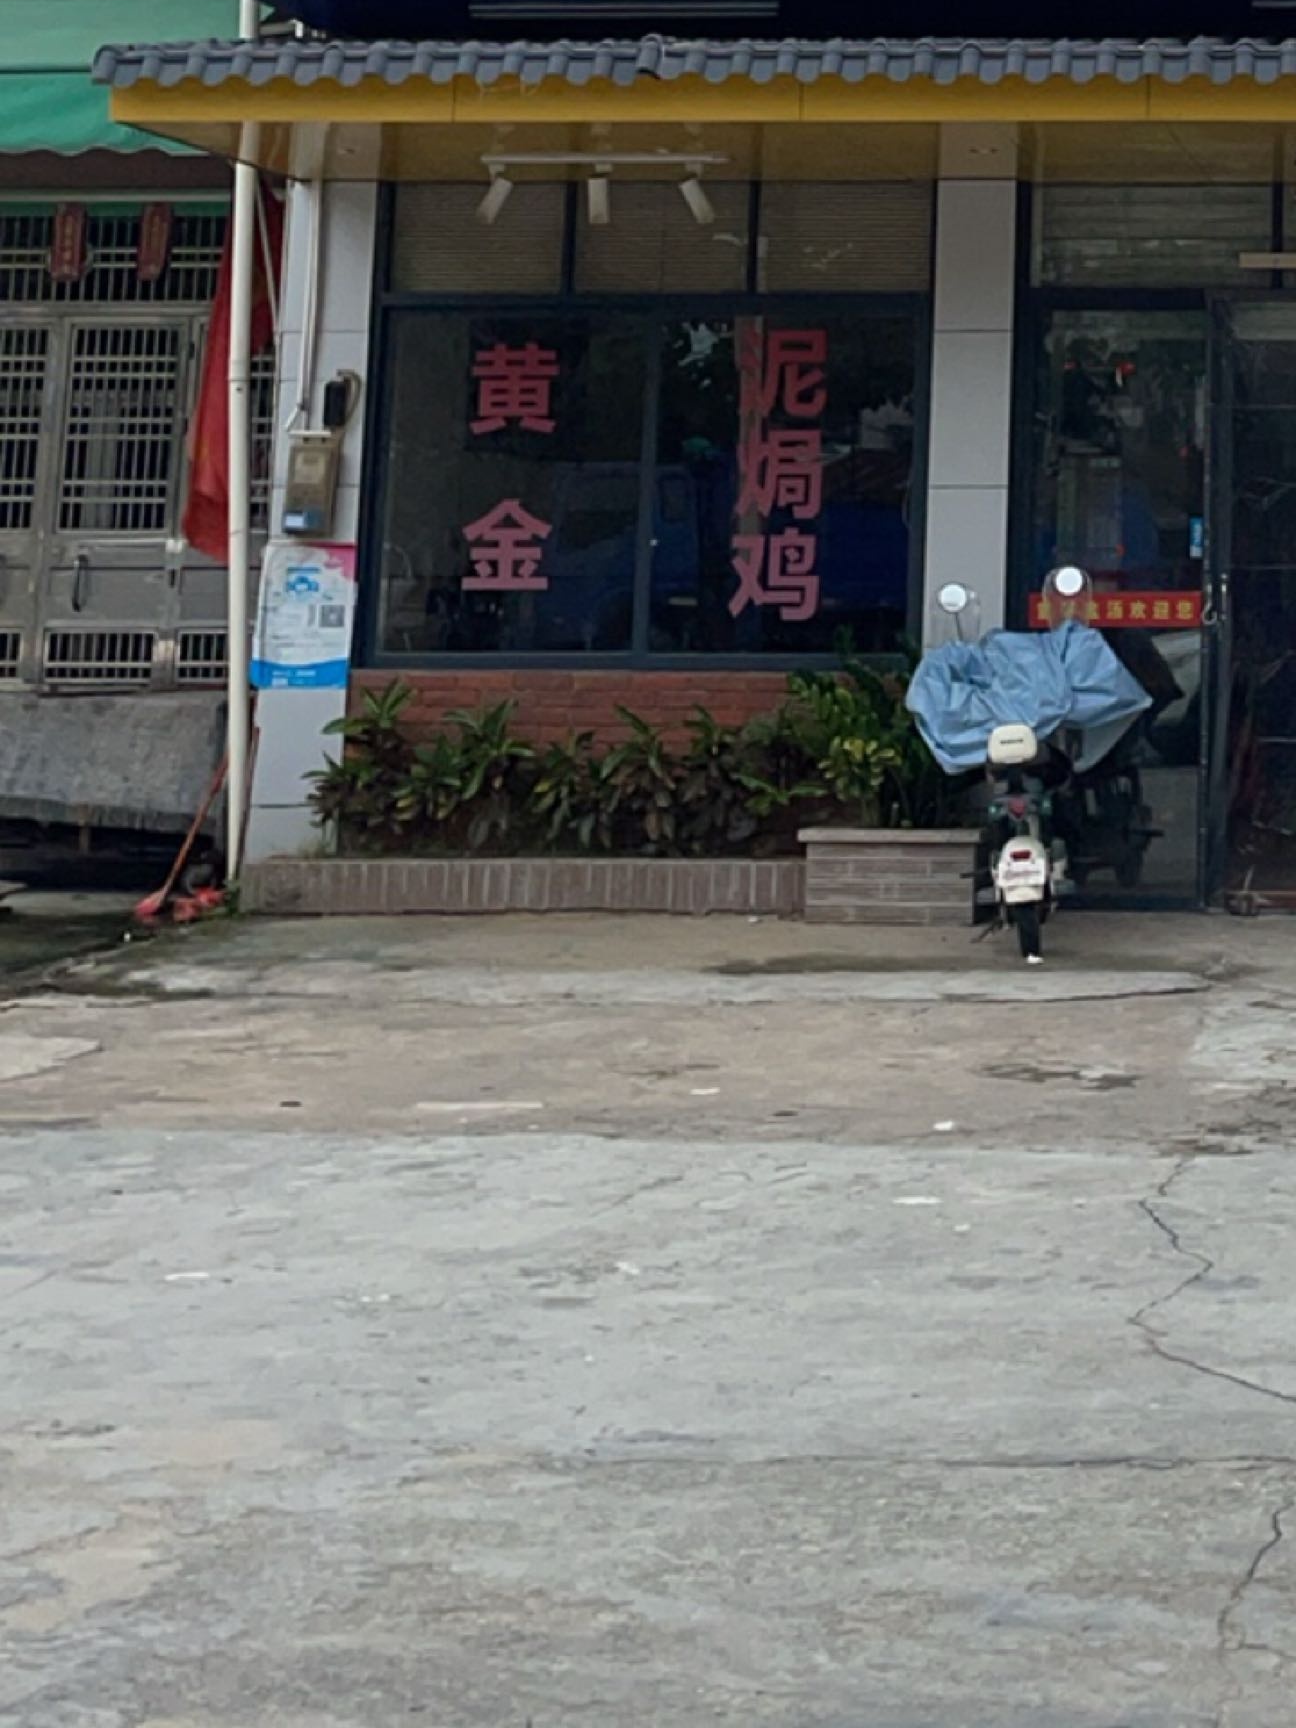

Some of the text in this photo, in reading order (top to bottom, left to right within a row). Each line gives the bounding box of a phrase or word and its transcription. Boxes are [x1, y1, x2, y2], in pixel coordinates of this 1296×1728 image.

[461, 341, 561, 593] 黄金
[728, 328, 828, 622] 泥焗鸡
